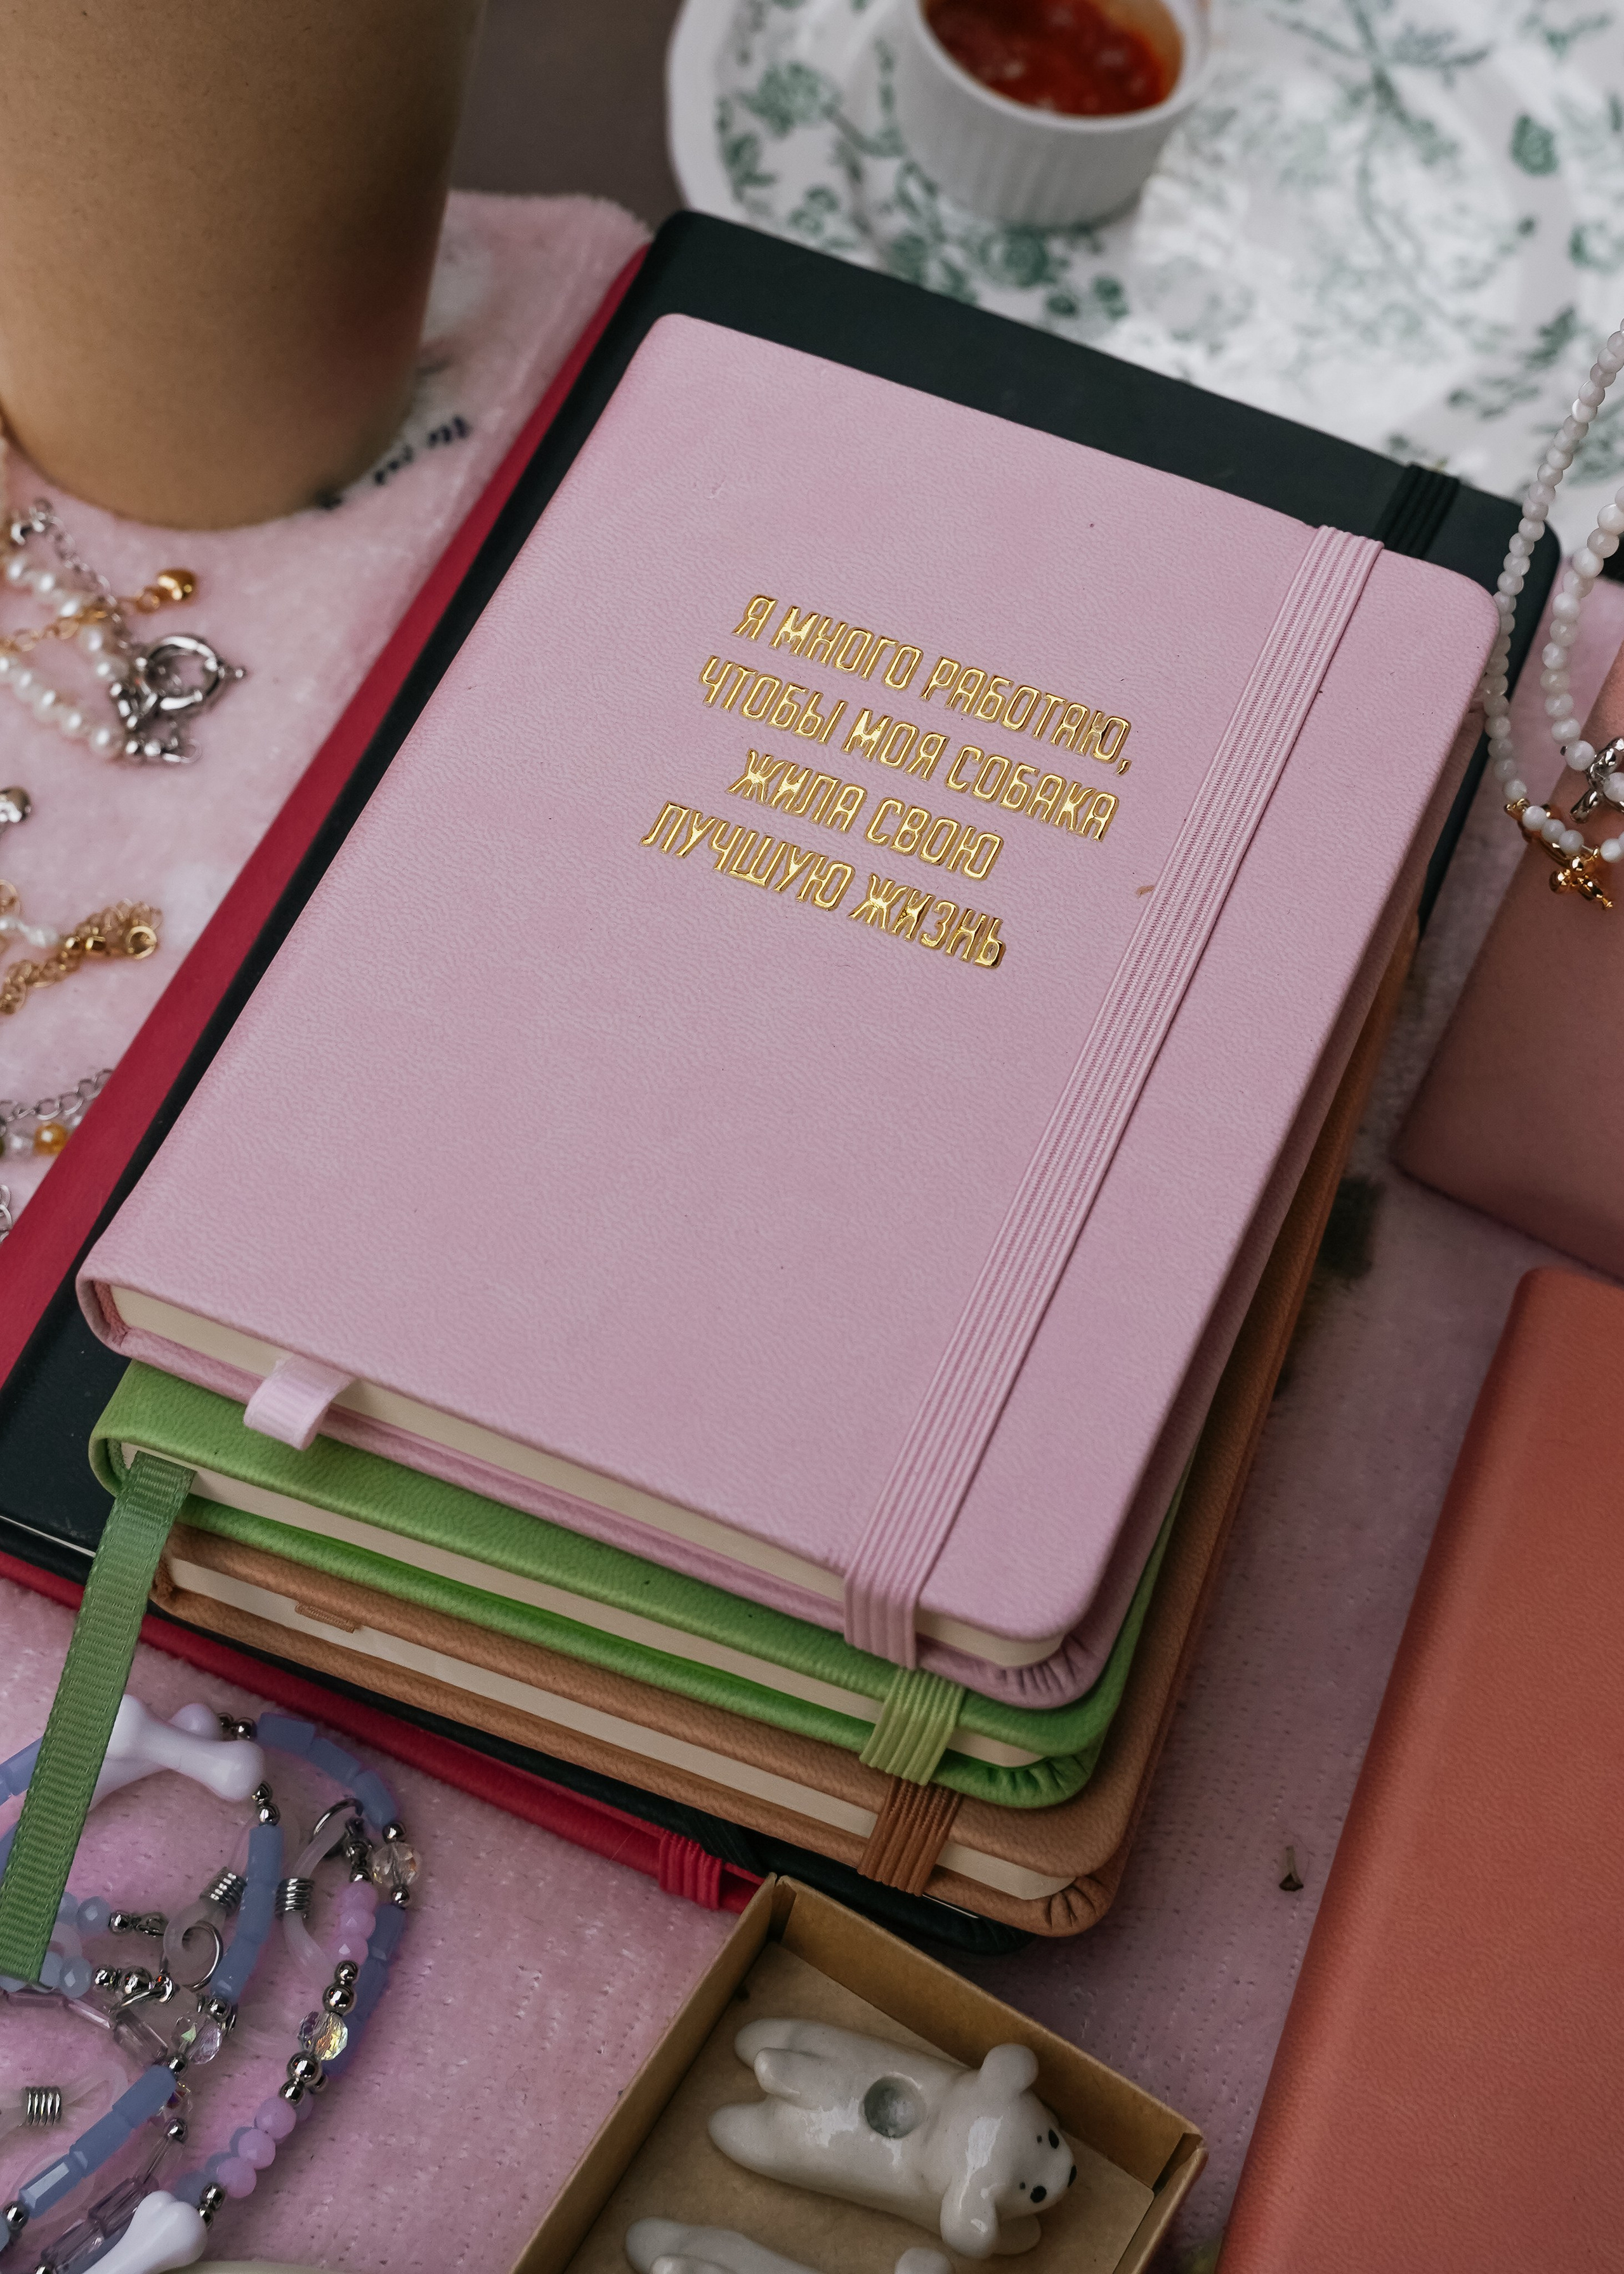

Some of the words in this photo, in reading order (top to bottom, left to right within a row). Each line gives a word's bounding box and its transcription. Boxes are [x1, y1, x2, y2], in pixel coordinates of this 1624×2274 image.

[700, 656, 848, 744] ЧТОБЫ
[842, 708, 947, 781] МОЯ
[945, 744, 1119, 841] СОБАКА
[733, 594, 778, 640] Я
[771, 606, 922, 691] МНОГО
[921, 656, 1132, 776] РАБОТАЮ,
[641, 801, 855, 910] ЛУЧШУЮ
[849, 874, 1007, 969] ЖИЗНЬ
[728, 749, 866, 832] ЖИЛА
[865, 799, 1004, 881] СВОЮ
